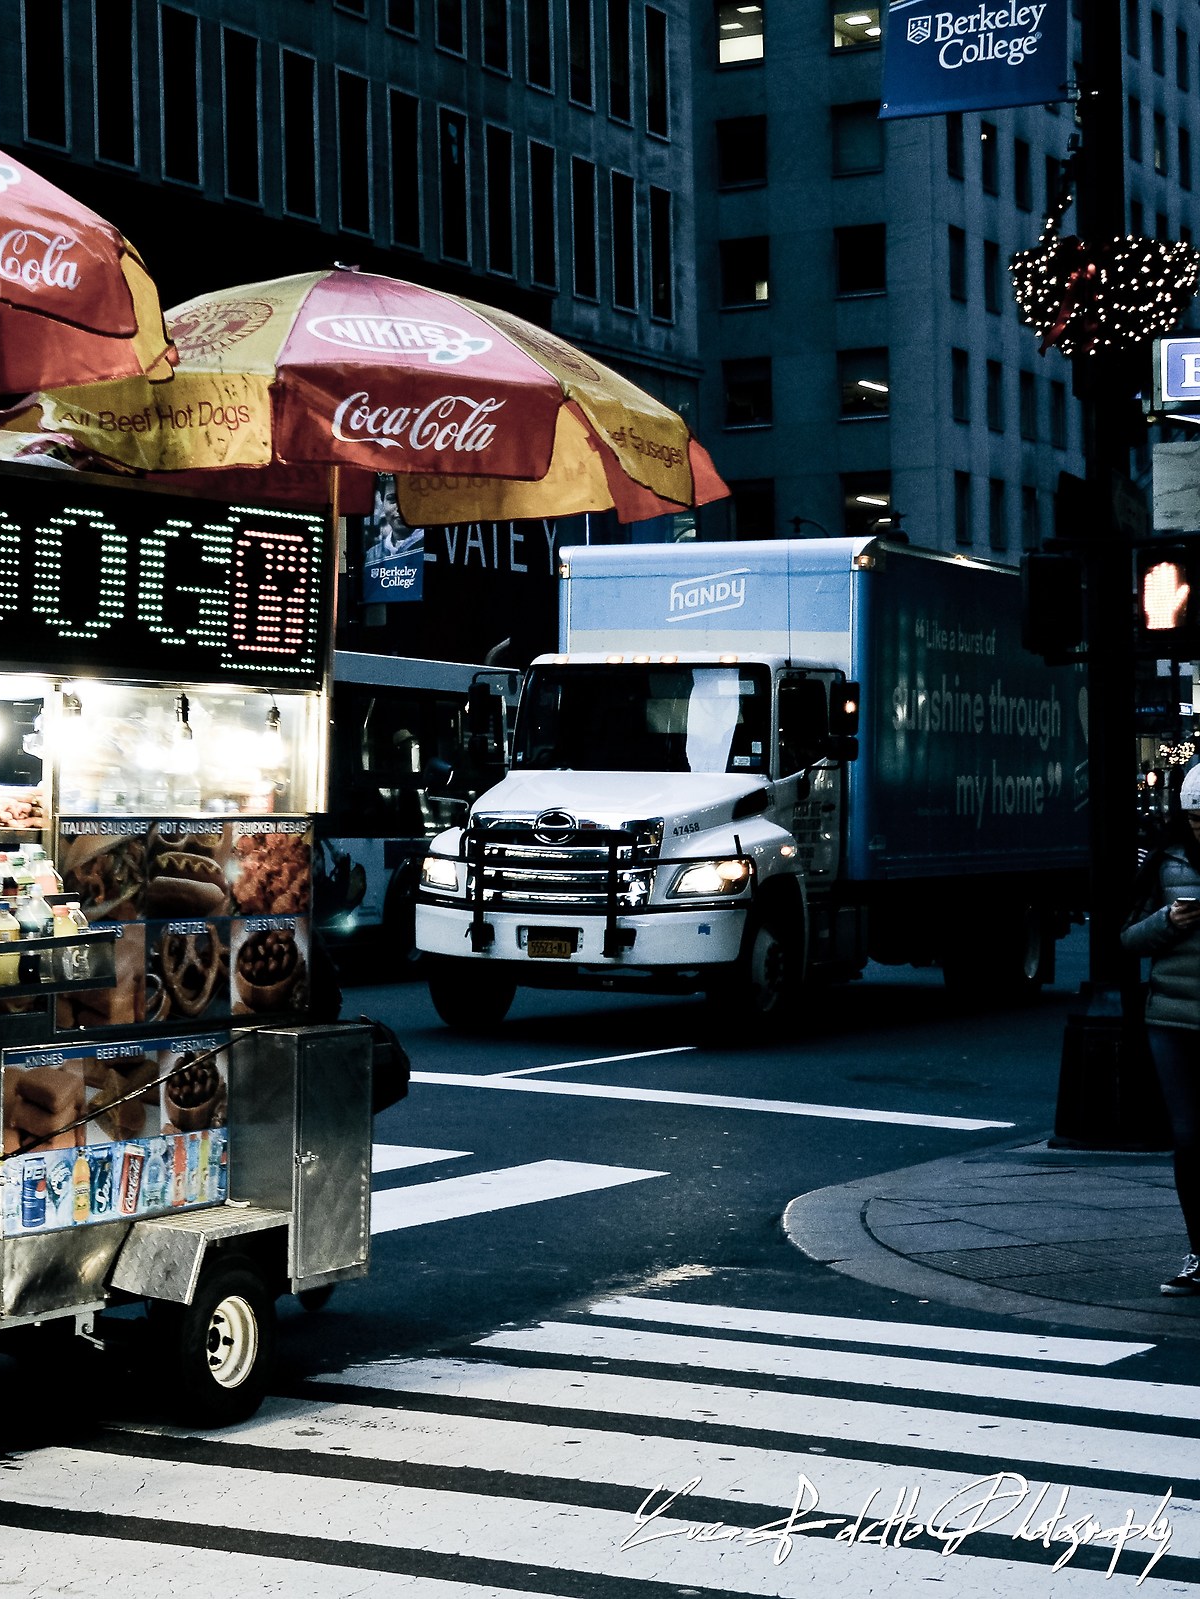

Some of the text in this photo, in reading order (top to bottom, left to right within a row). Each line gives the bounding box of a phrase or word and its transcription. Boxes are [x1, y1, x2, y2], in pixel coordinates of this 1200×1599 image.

[934, 0, 1047, 43] Berkeley
[330, 319, 447, 350] NIKAS
[59, 402, 250, 433] All Beef Hot Dogs
[331, 391, 507, 453] Coca-Cola
[380, 566, 417, 579] Berkeley
[381, 576, 415, 589] College
[958, 624, 984, 654] burst
[989, 679, 1061, 751] through
[957, 774, 987, 829] my
[61, 821, 147, 835] ITALIAN SAUSAGE
[157, 821, 223, 835] HOT SAUSAGE
[237, 821, 307, 835] CHICKEN KEBAB
[673, 822, 700, 836] 47458
[168, 922, 209, 935] PRETZEL
[244, 918, 296, 933] CHESTNUTS
[96, 1045, 144, 1061] BEEF PATTY
[170, 1038, 217, 1054] CHESTNUTS
[25, 1052, 64, 1069] KNISHES
